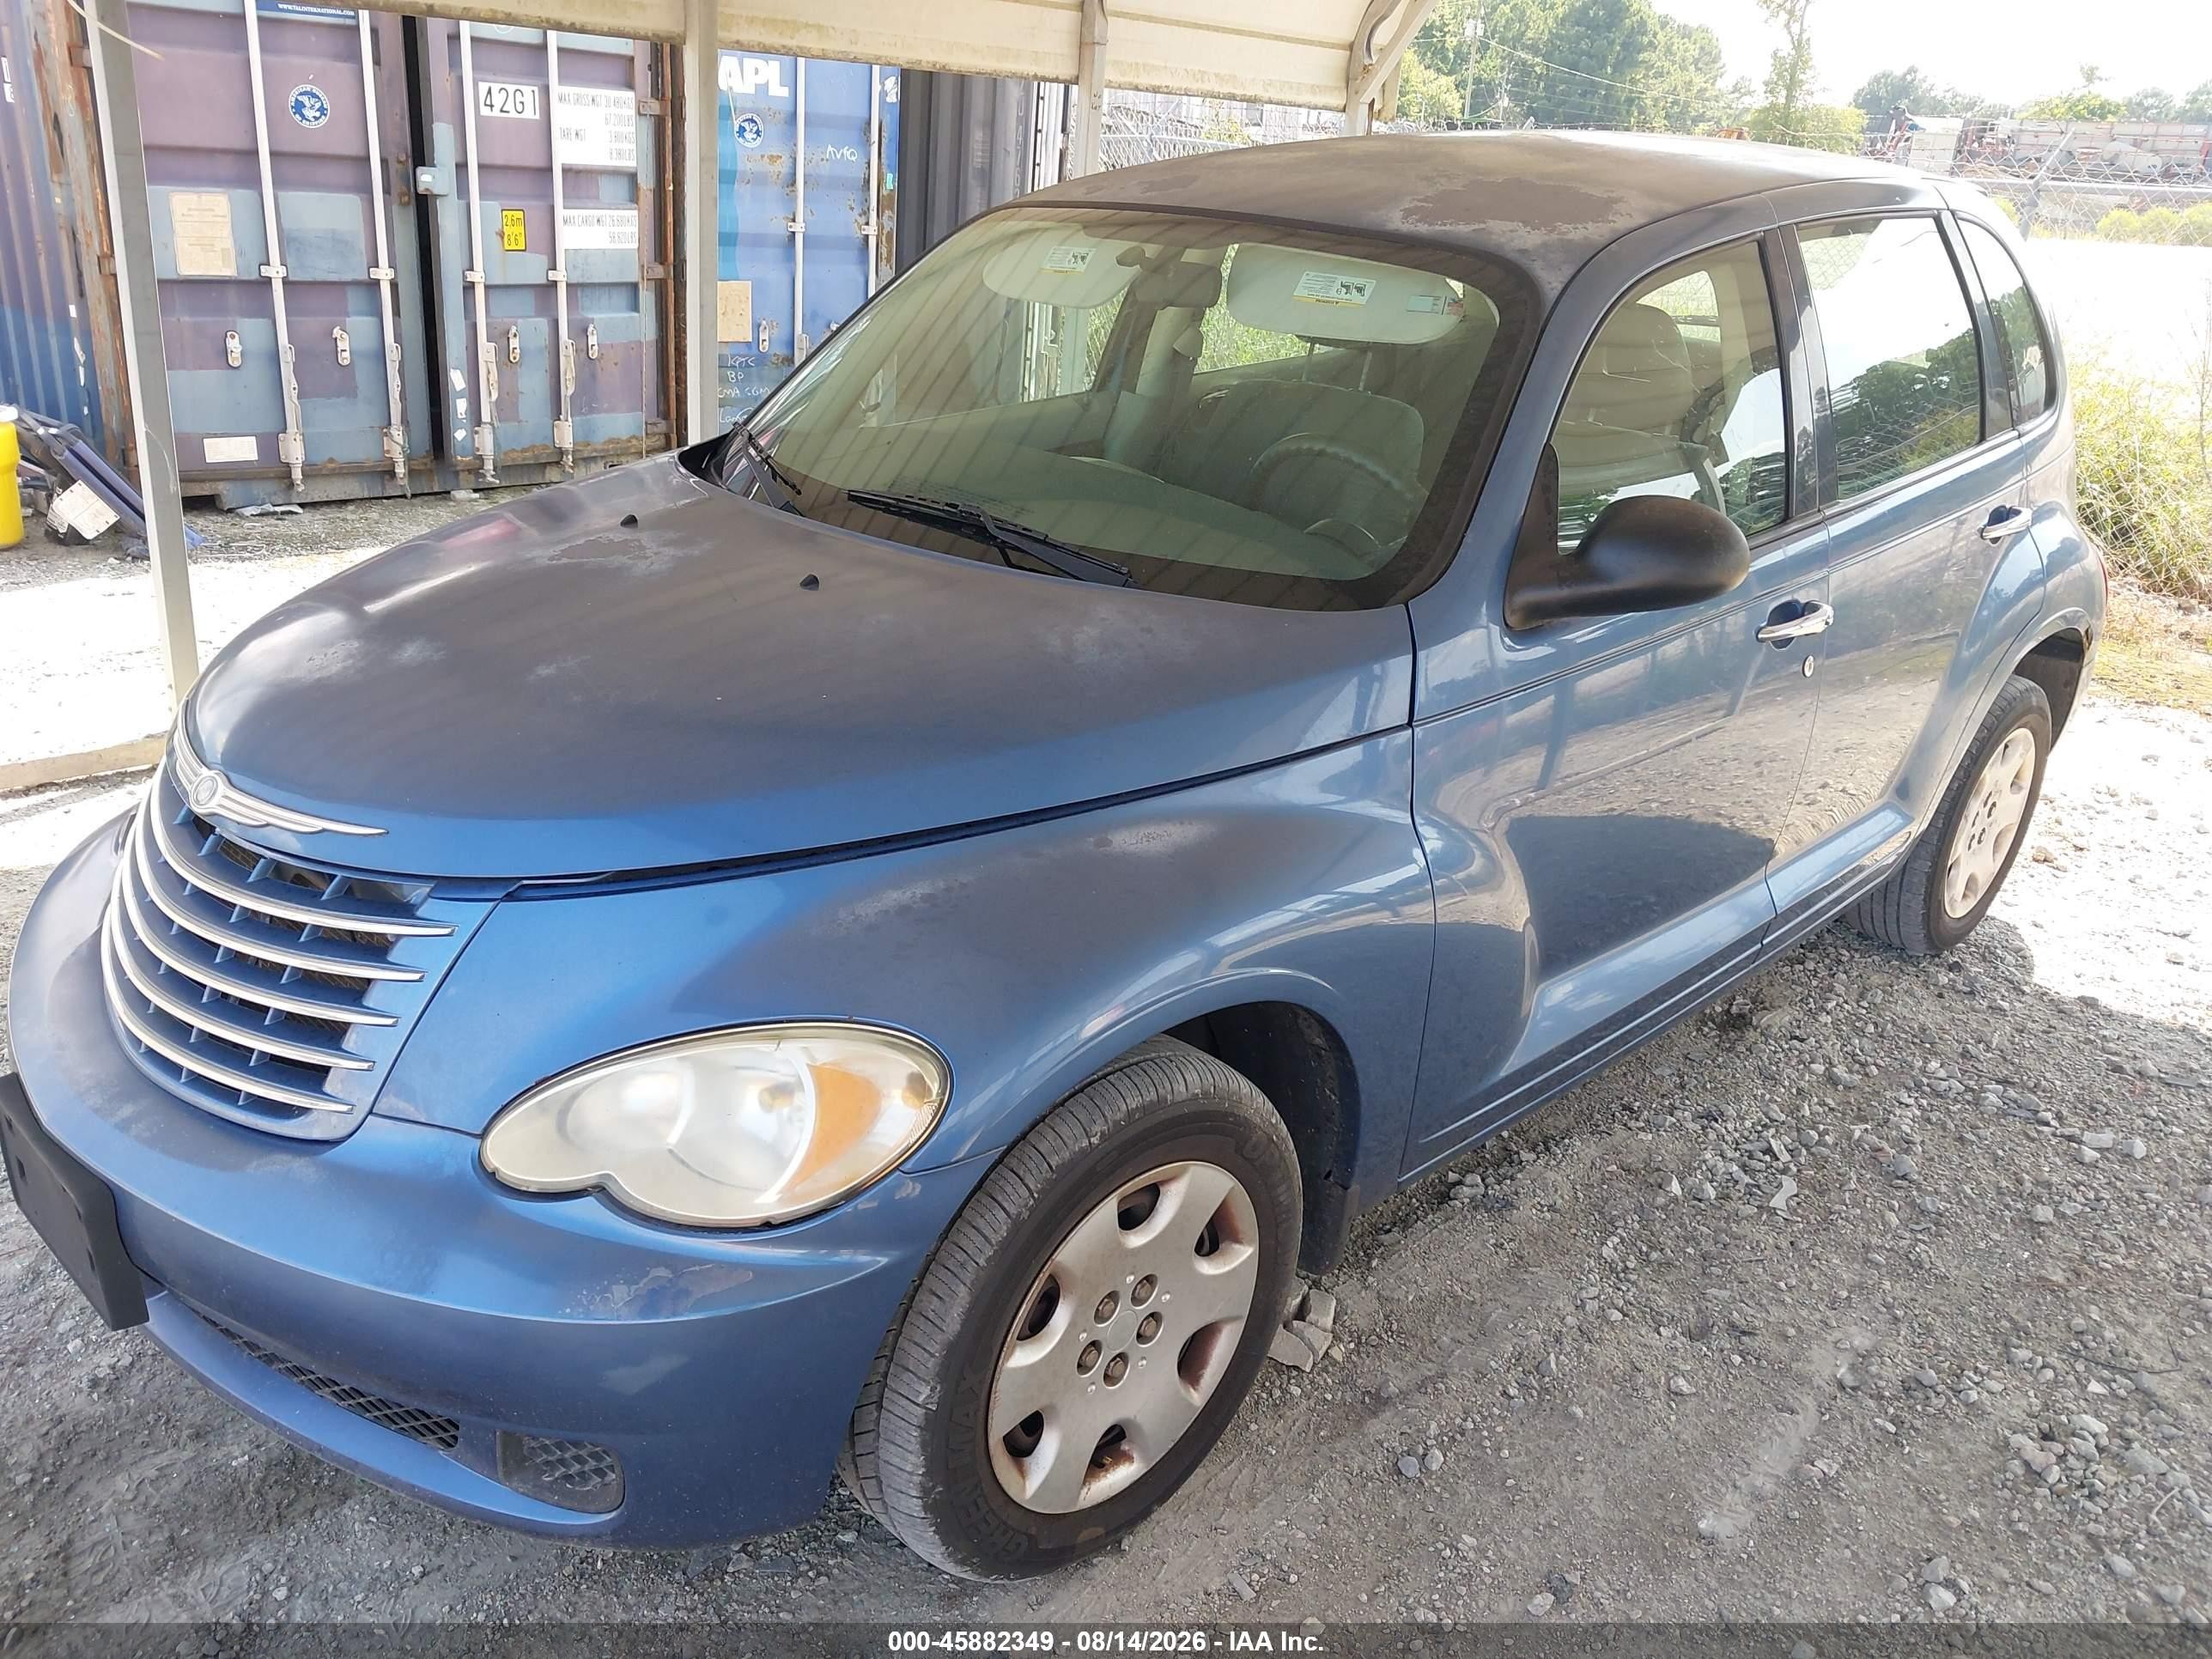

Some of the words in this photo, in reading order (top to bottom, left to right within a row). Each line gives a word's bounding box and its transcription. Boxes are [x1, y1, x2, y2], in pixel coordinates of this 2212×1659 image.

[718, 55, 789, 97] APL
[483, 85, 537, 117] 42G1
[557, 92, 571, 105] MAX
[573, 93, 590, 106] GROSS
[559, 126, 572, 142] TARE
[562, 215, 576, 227] MAX
[577, 215, 595, 227] CARGO
[727, 371, 744, 383] BP
